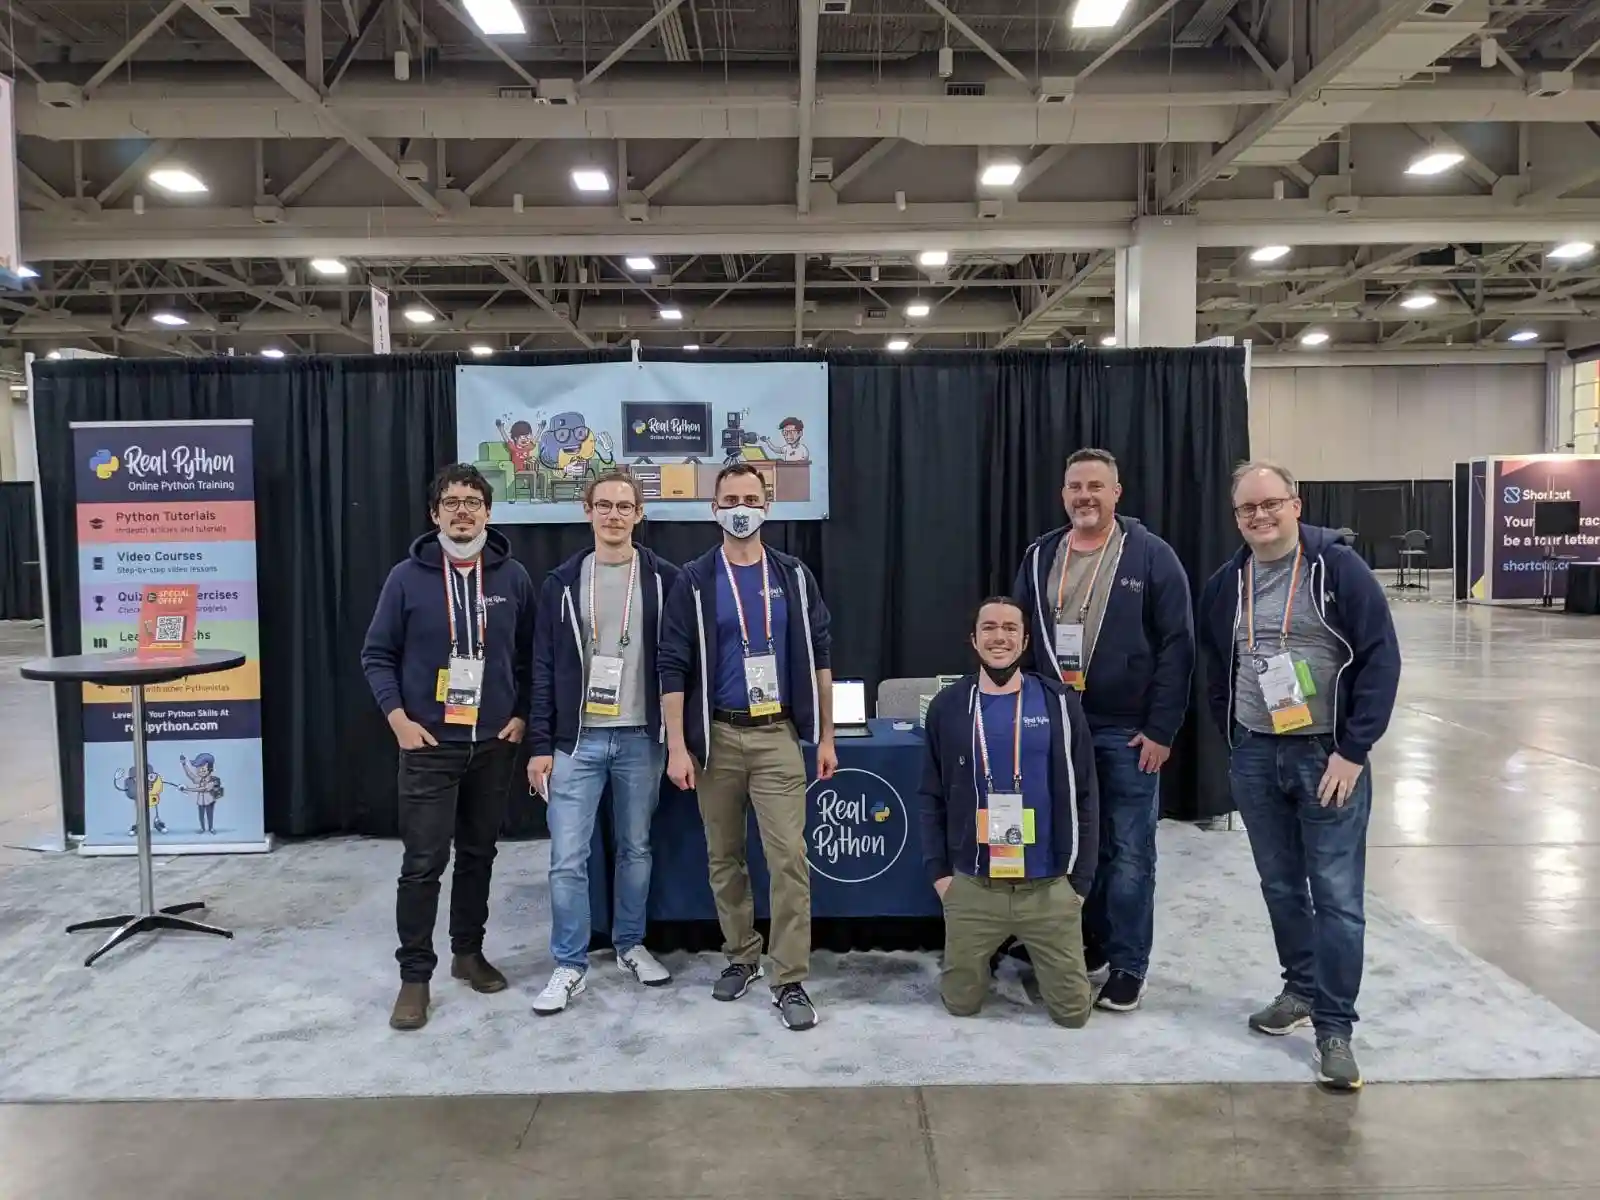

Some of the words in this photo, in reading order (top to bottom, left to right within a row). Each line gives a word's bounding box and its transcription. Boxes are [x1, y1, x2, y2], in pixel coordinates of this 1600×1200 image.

[648, 418, 669, 433] Real
[670, 418, 700, 435] Python
[124, 445, 168, 477] Real
[171, 446, 234, 480] Python
[128, 481, 159, 491] Online
[161, 481, 195, 492] Python
[198, 480, 235, 491] Training
[116, 512, 160, 524] Python
[163, 511, 216, 521] Tutorials
[1504, 516, 1535, 527] Your
[1504, 534, 1521, 546] be
[1523, 537, 1531, 546] a
[1534, 536, 1562, 545] four
[1564, 534, 1600, 545] letter
[117, 552, 151, 561] Video
[154, 552, 203, 561] Courses
[117, 566, 165, 575] Step-by-step
[190, 565, 217, 573] lessons
[196, 590, 239, 600] ercises
[168, 710, 196, 720] Python
[198, 709, 218, 717] Skills
[124, 721, 218, 734] relpython.com
[817, 789, 868, 825] Real
[812, 824, 885, 864] Python
